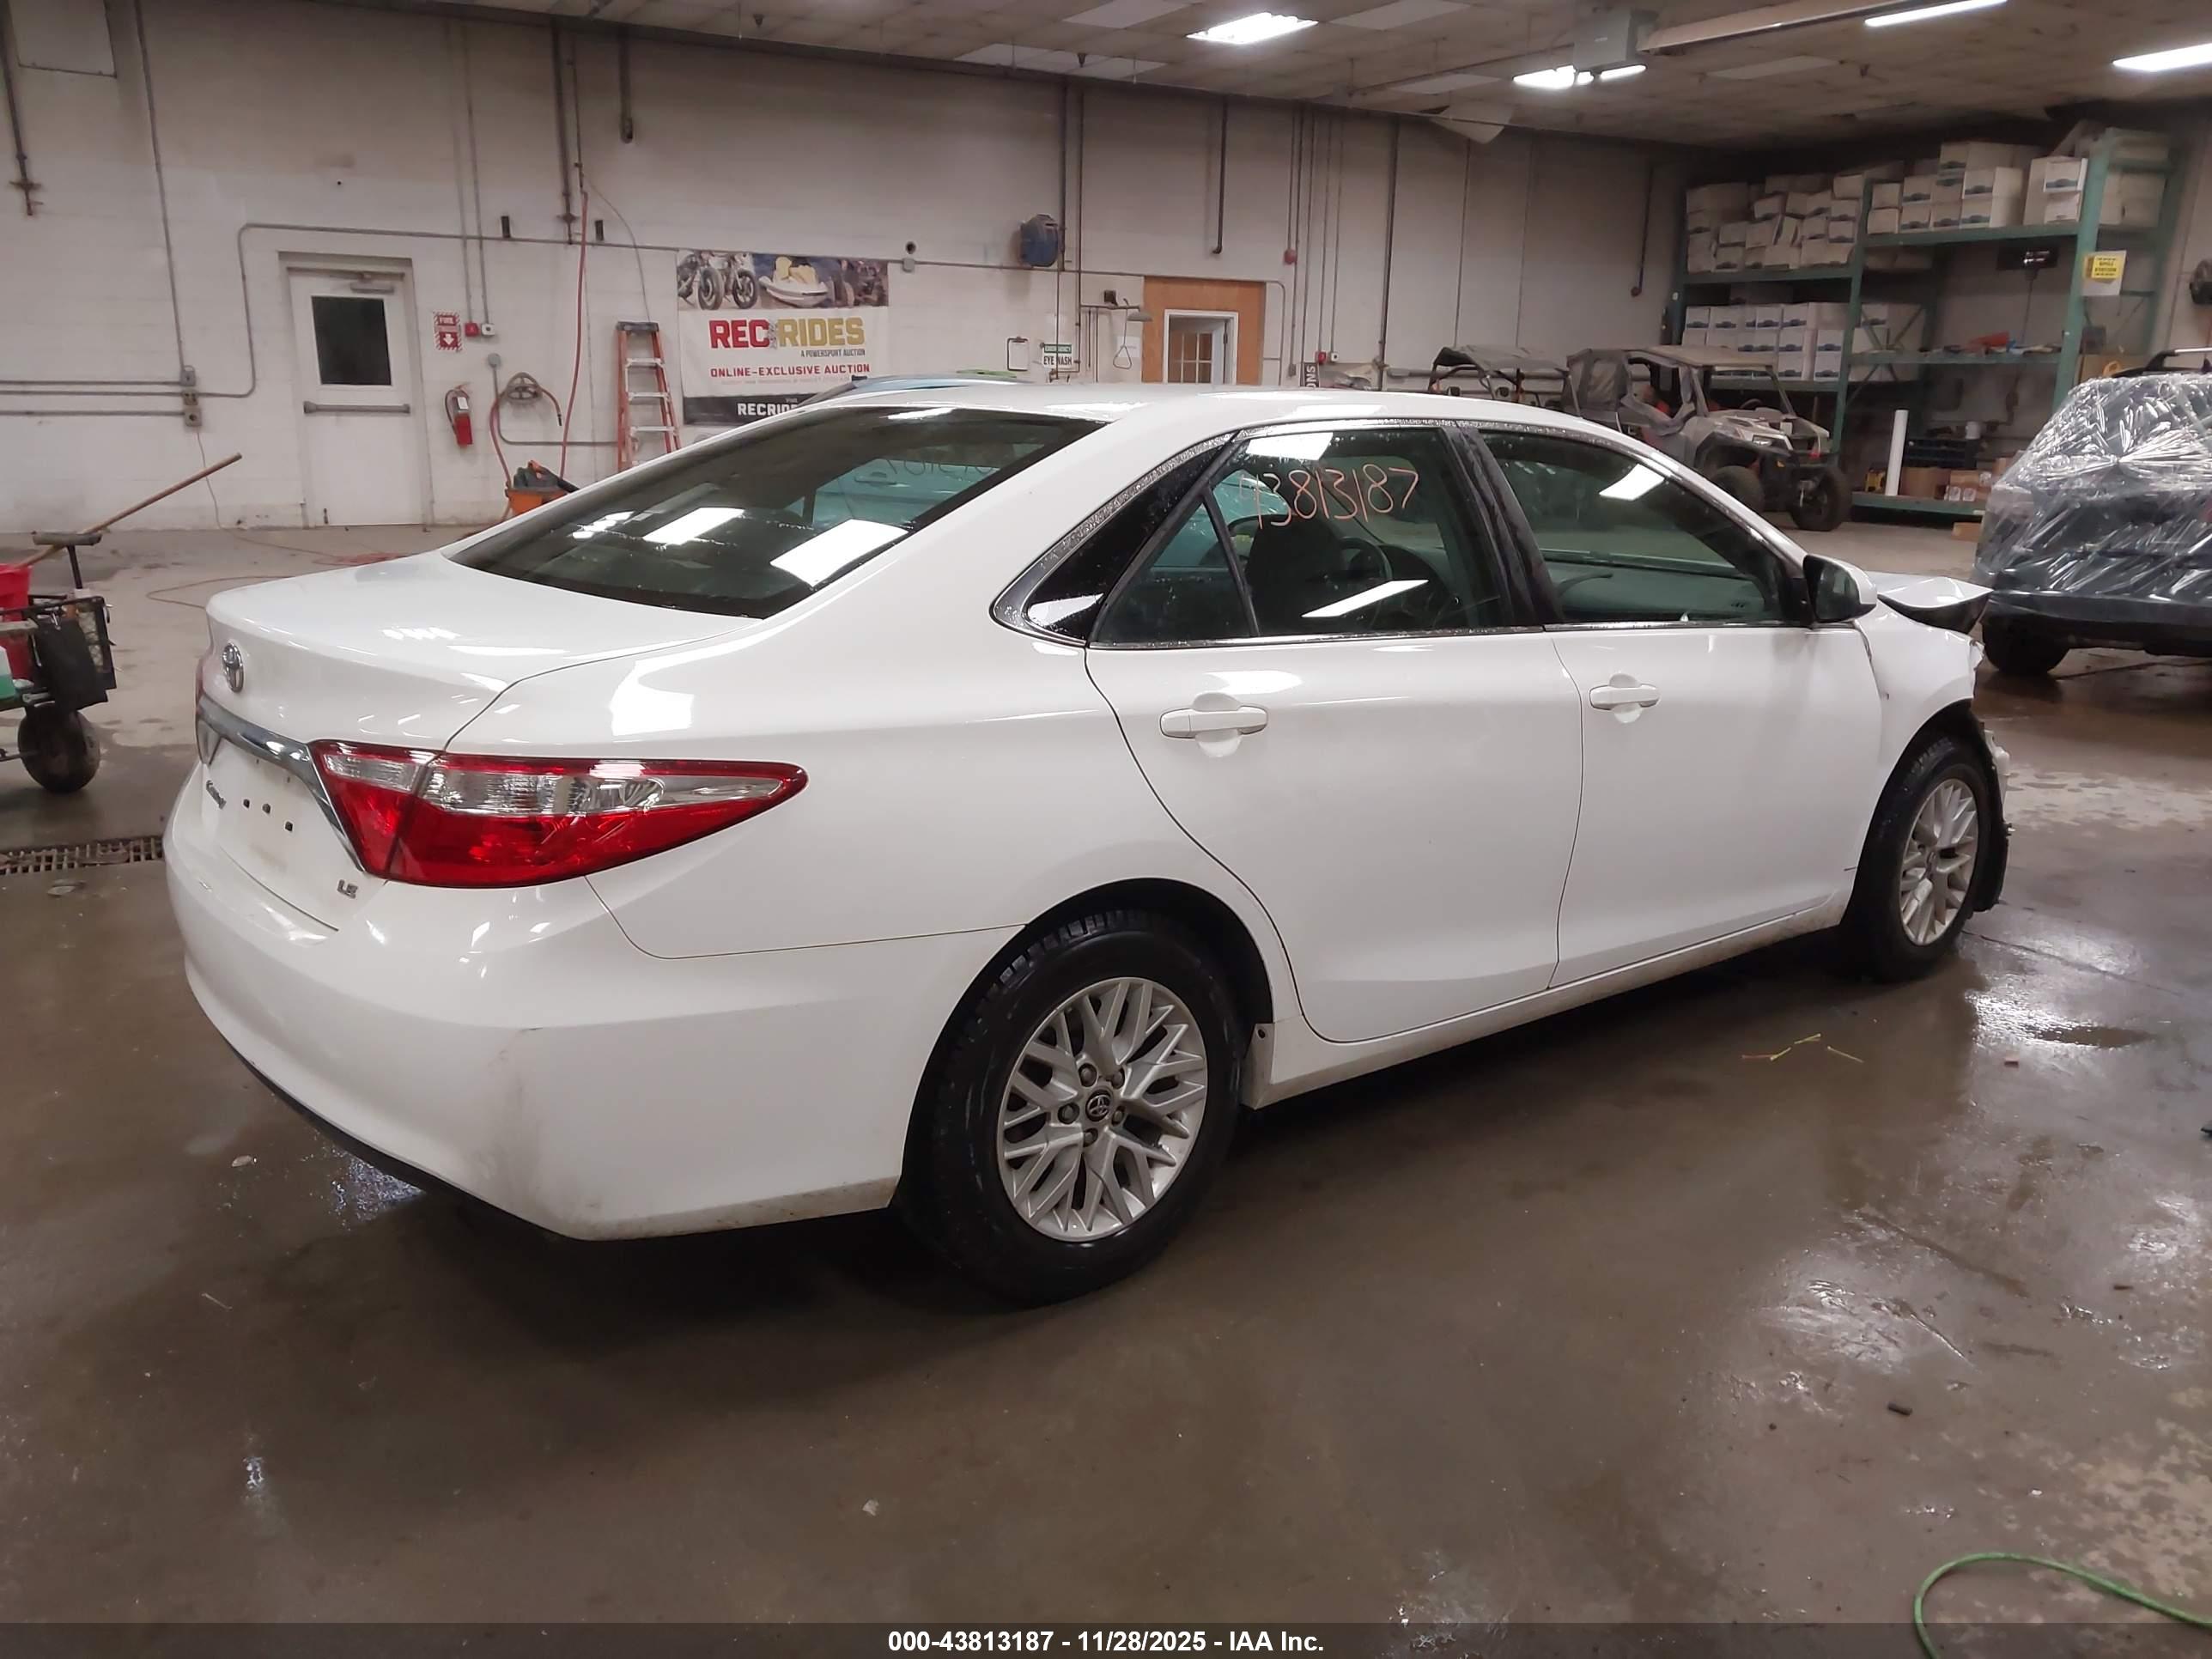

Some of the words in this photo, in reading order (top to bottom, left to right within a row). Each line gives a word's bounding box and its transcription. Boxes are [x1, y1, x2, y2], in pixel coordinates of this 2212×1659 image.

[708, 319, 770, 348] REC
[777, 317, 865, 347] RIDES
[710, 365, 820, 378] ONLINE-EXCLUSIVE
[823, 363, 870, 374] AUCTION
[1043, 356, 1054, 366] EYE
[1239, 464, 1419, 529] 43813187
[337, 879, 358, 899] LE
